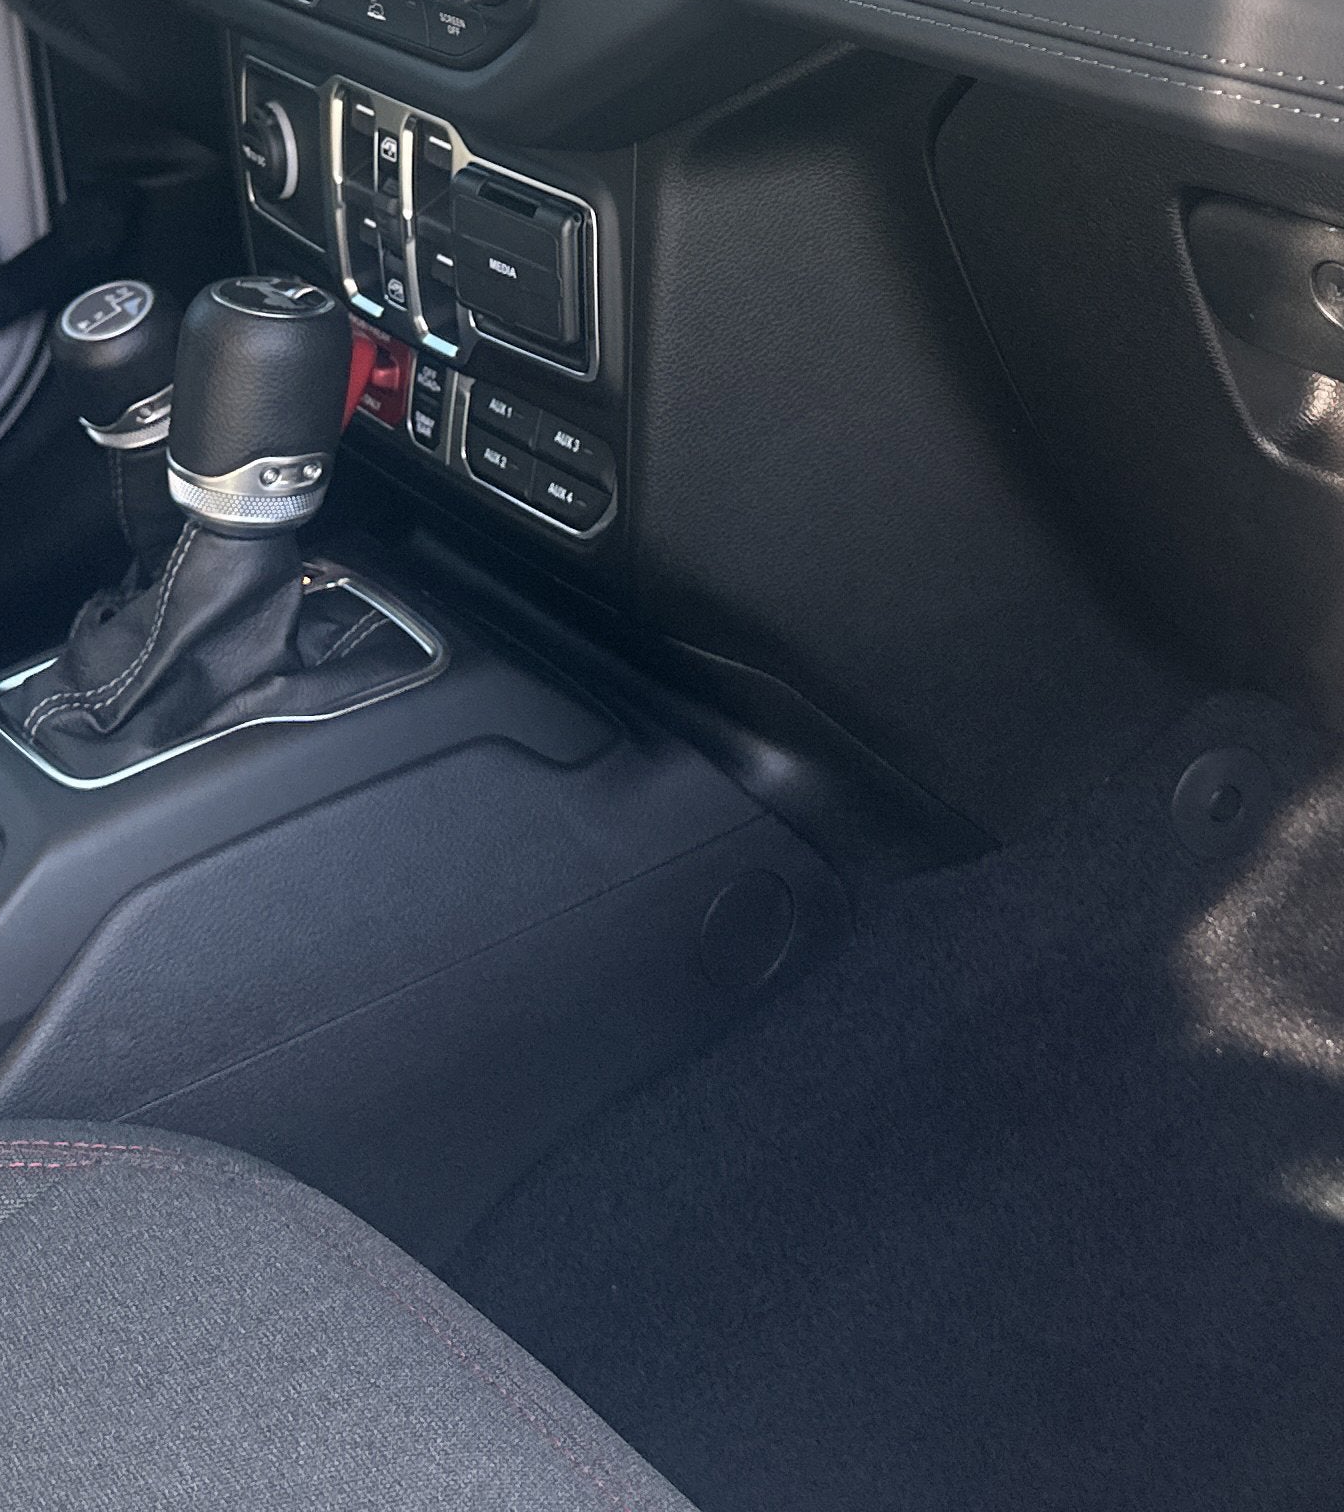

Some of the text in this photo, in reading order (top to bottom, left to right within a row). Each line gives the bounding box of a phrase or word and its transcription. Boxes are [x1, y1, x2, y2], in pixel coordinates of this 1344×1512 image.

[439, 11, 466, 29] SCREEN
[488, 257, 518, 280] MEDIA
[489, 398, 507, 416] AUX
[554, 431, 573, 449] AUX
[484, 448, 502, 466] AUX
[548, 482, 567, 500] AUX
